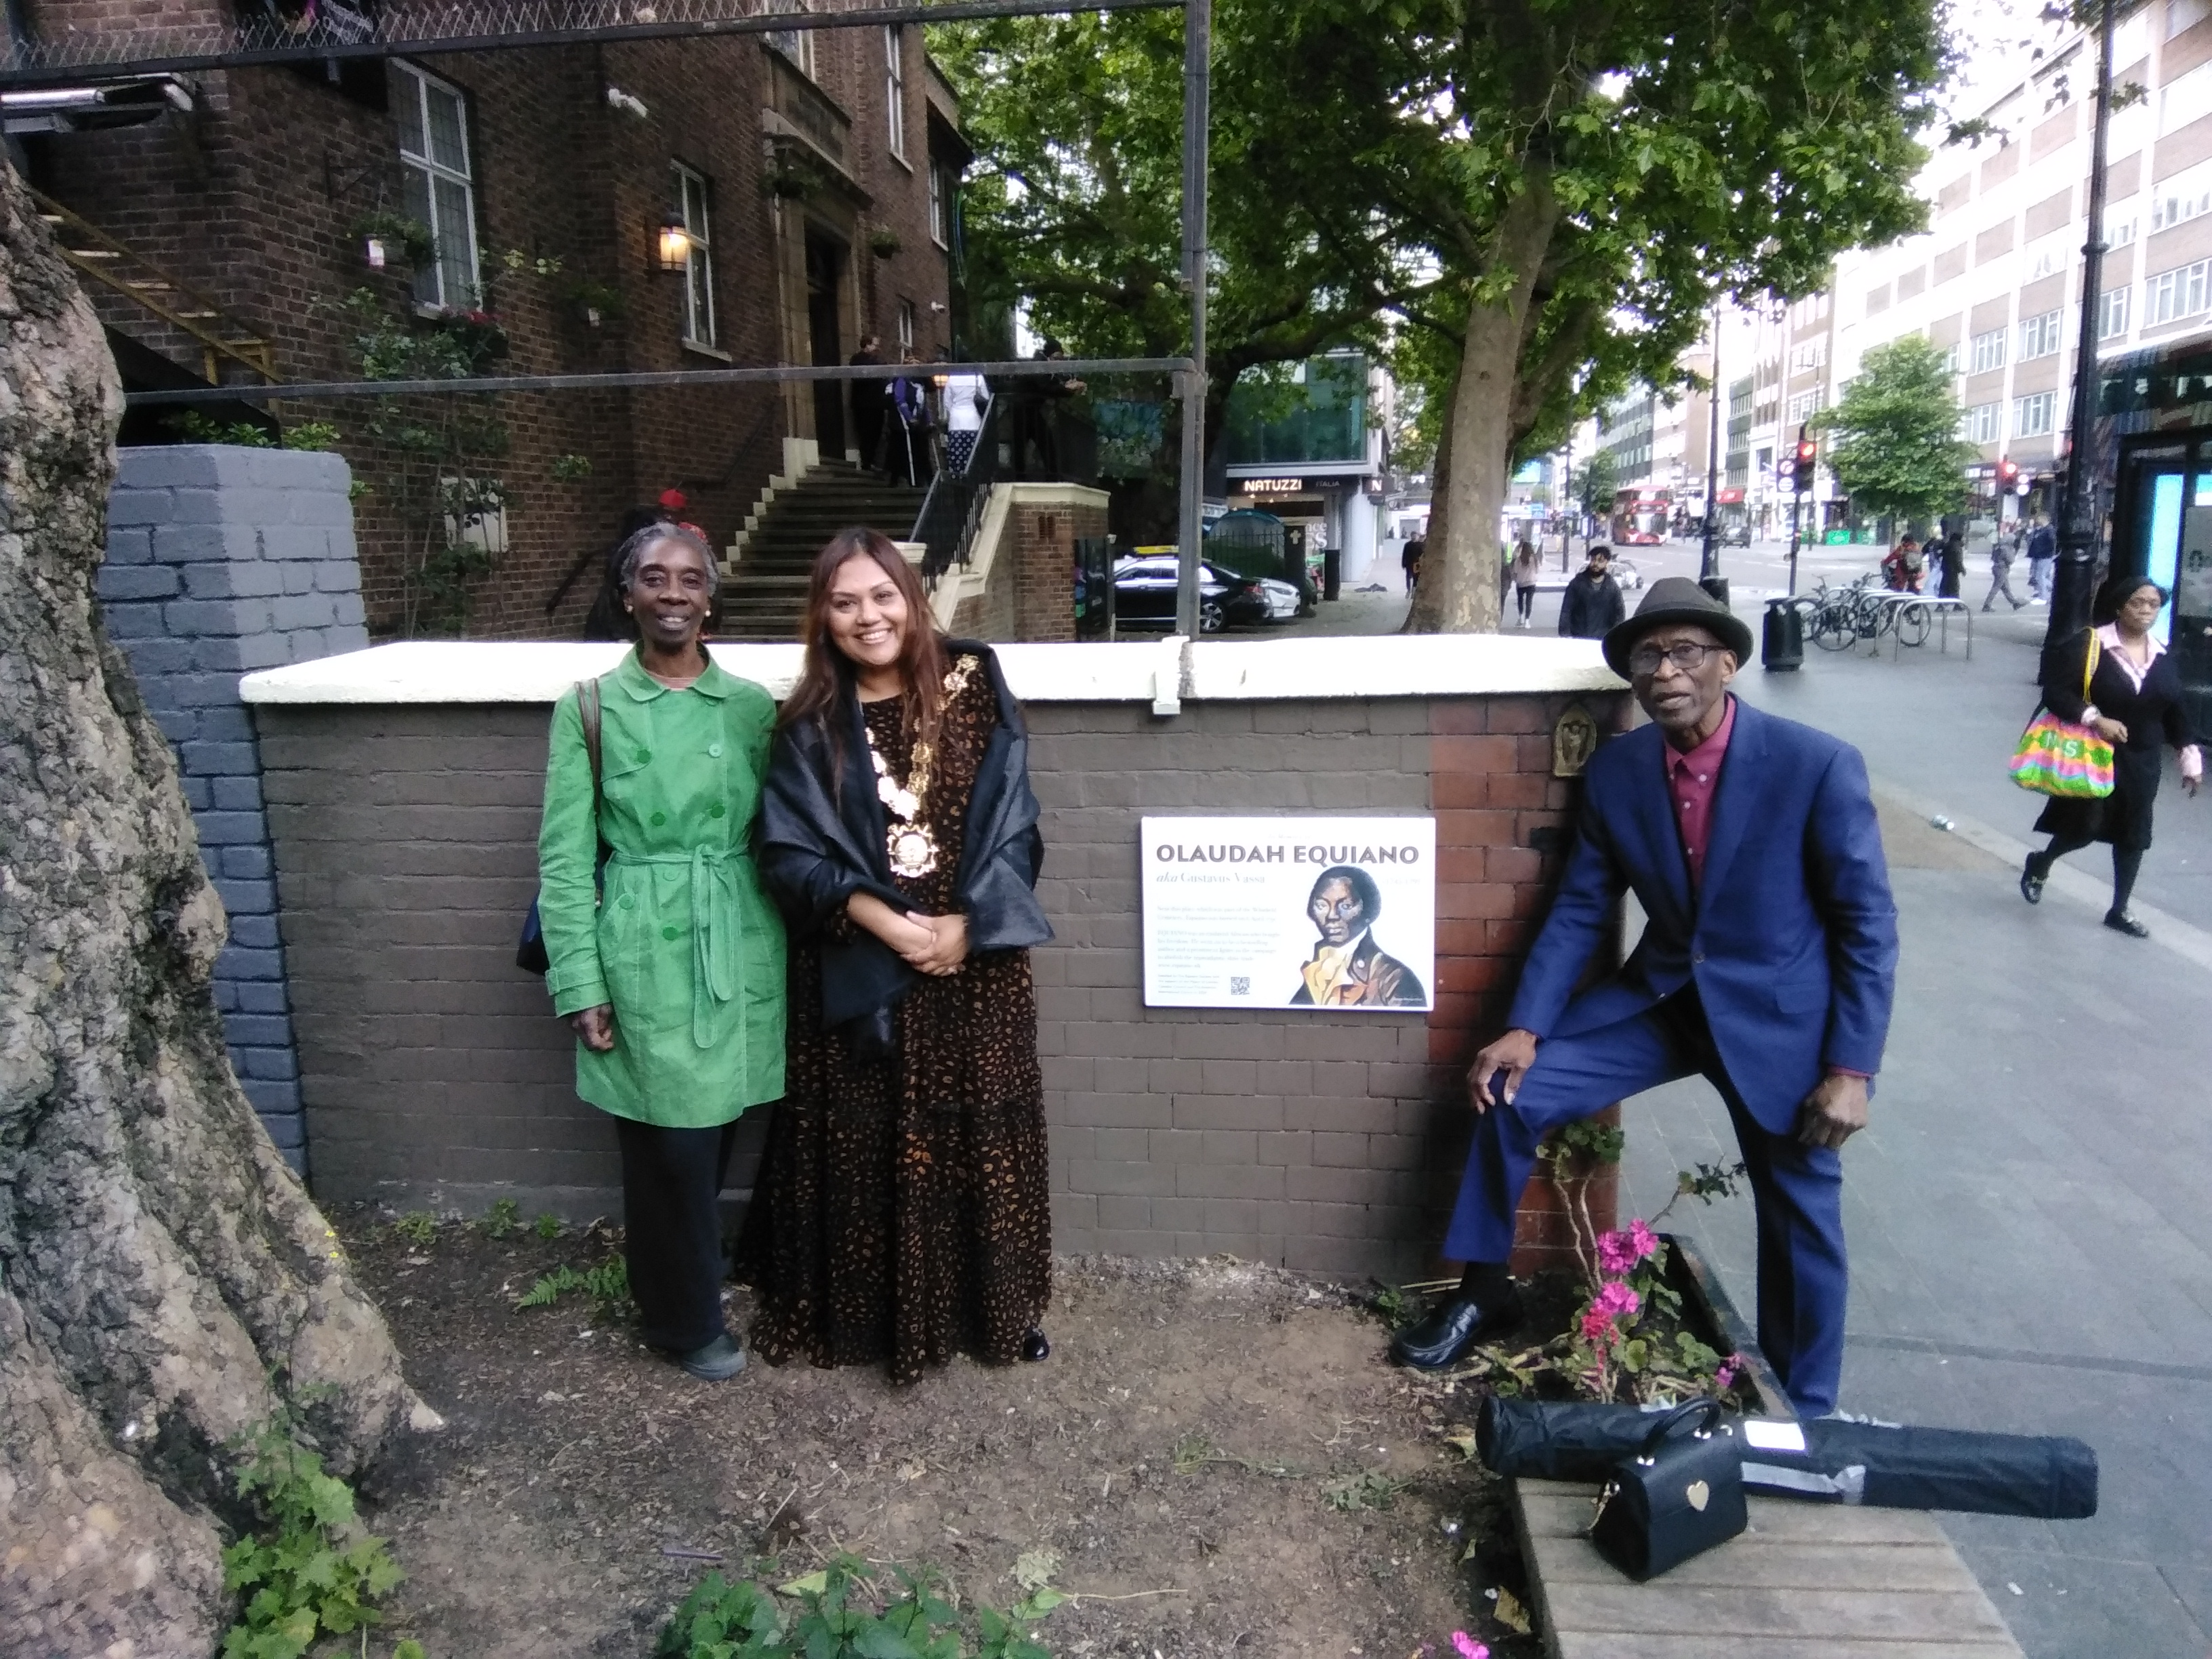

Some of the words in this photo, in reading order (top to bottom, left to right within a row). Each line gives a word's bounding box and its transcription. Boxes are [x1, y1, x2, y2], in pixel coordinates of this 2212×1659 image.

[1244, 478, 1303, 492] NATUZZI
[1372, 480, 1382, 492] N
[1156, 844, 1285, 863] OLAUDAH
[1294, 845, 1420, 867] EQUIANO
[1155, 872, 1179, 883] aka
[1181, 872, 1231, 884] Gustavus
[1234, 872, 1266, 884] Vassa
